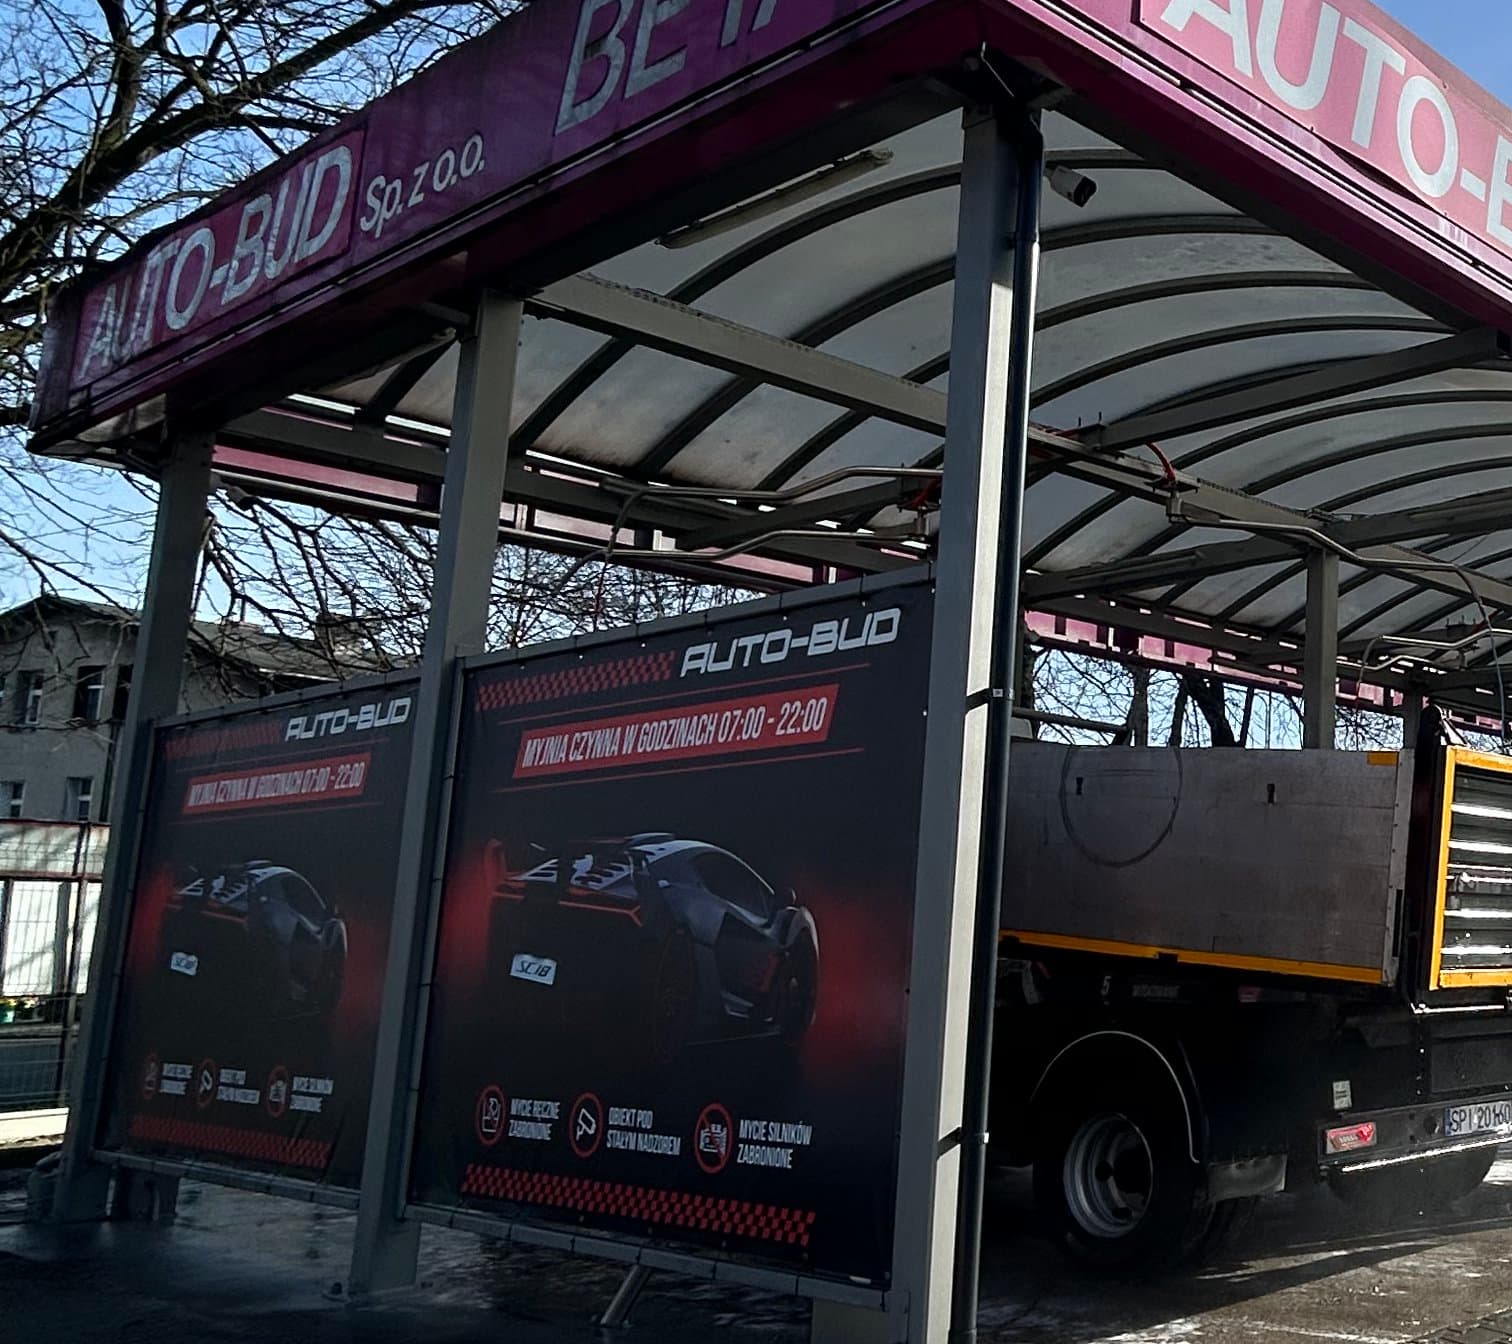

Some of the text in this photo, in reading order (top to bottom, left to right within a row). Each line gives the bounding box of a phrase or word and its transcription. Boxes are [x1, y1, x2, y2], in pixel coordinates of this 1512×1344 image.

[80, 145, 352, 379] AUTO-BUD
[360, 175, 402, 238] Sp.
[408, 161, 429, 207] z
[680, 608, 901, 678] AUTO-BUD
[285, 697, 412, 741] AUTO-BUD
[522, 736, 567, 768] MYJNIA
[569, 728, 621, 762] CZYNNA
[622, 727, 636, 755] W
[637, 713, 716, 754] GODZINACH
[718, 706, 766, 744] 07:00
[775, 697, 828, 737] 22:00
[301, 766, 331, 794] 07:00
[335, 761, 365, 789] 22:00
[608, 1107, 653, 1129] OBIEKT POD
[738, 1119, 812, 1146] MYCIE SILNIKÓW
[606, 1129, 681, 1155] STAŁYM NADZOREM
[736, 1144, 793, 1169] ZABRONIONE
